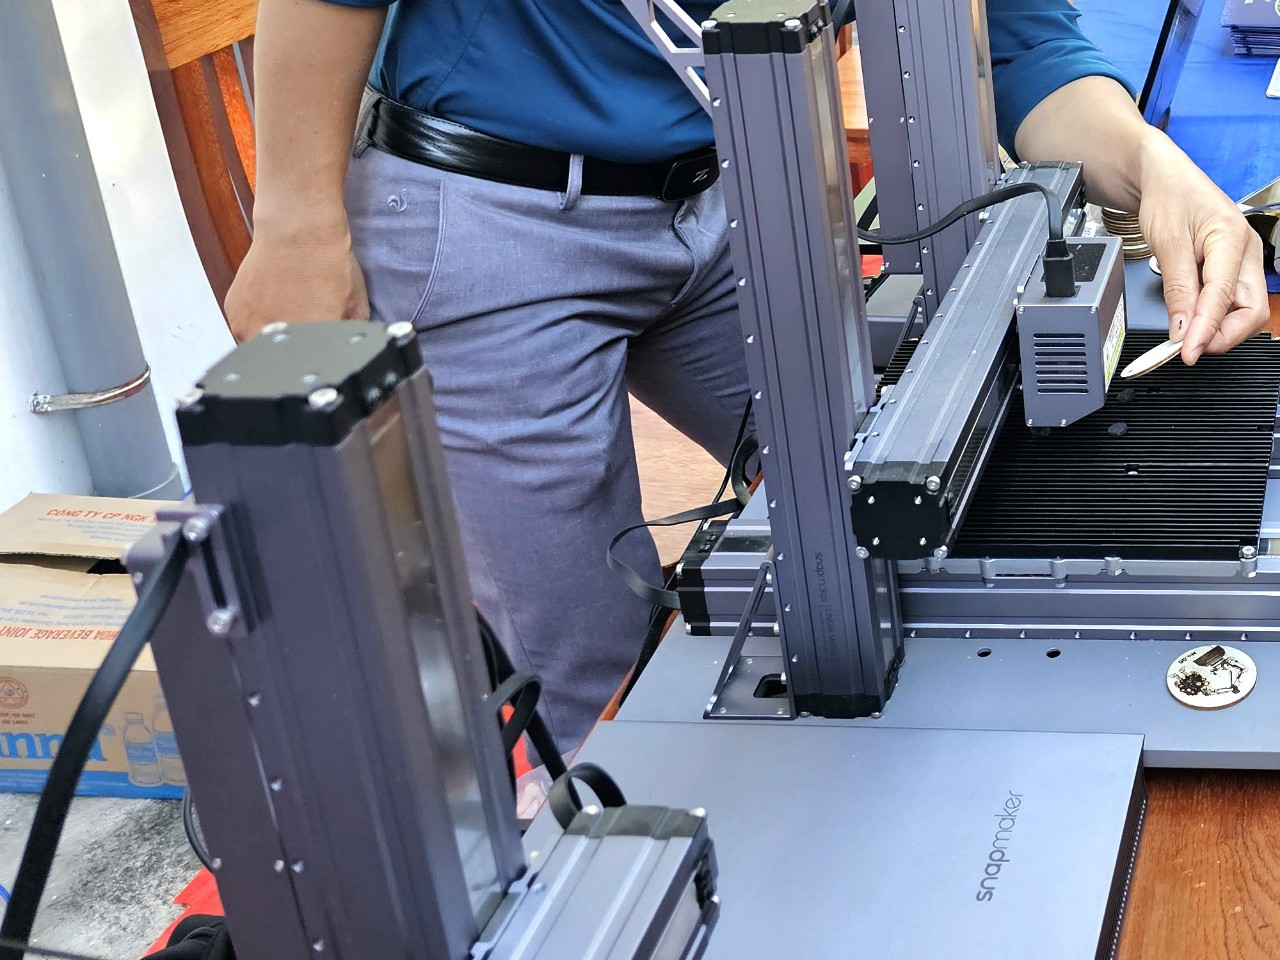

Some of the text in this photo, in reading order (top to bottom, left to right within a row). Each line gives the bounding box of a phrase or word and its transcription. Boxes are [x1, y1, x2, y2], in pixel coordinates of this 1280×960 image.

[46, 508, 81, 517] CÔNG
[83, 510, 100, 519] TY
[102, 512, 121, 520] CP
[120, 513, 148, 522] NGK
[814, 551, 829, 602] snapmaker
[30, 628, 94, 640] BEVERAGE
[976, 789, 1024, 902] snapmaker
